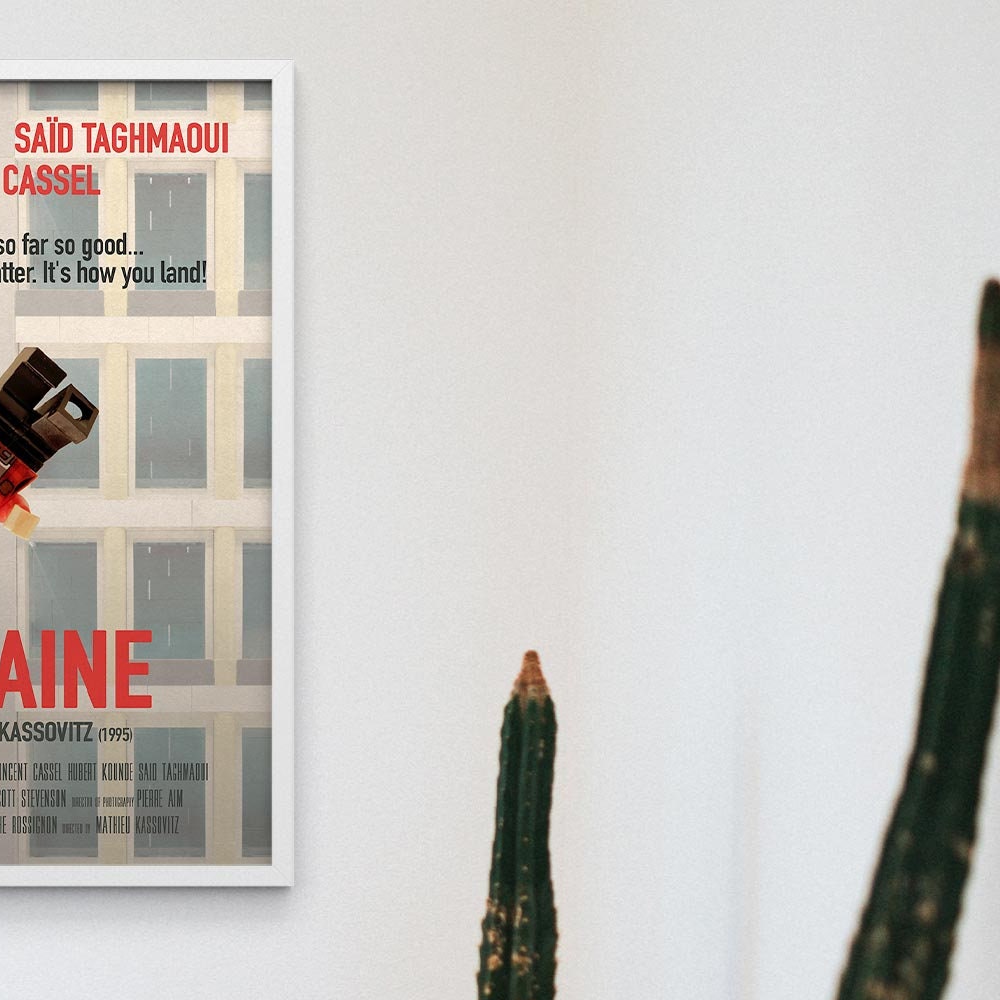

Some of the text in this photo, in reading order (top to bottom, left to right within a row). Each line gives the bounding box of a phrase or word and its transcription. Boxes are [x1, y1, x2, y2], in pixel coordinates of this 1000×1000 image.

[14, 116, 229, 154] SAÏD TAGHMAOUI
[2, 164, 101, 196] CASSEL
[21, 232, 49, 256] far
[54, 238, 76, 256] so
[81, 232, 144, 260] good...
[42, 260, 72, 284] It's
[76, 260, 116, 284] how
[121, 267, 155, 289] you
[159, 260, 208, 284] land!
[97, 727, 134, 744] (1995)
[32, 762, 63, 781] CASSEL
[68, 762, 97, 781] HUBERT
[102, 762, 134, 781] KOUNDE
[138, 762, 157, 781] SAID
[162, 762, 209, 781] TAGHMAOUI
[21, 789, 67, 808] STEVENSON
[137, 789, 163, 808] PIERRE
[168, 789, 184, 808] AIM
[12, 815, 58, 834] ROSSIGNON
[96, 815, 131, 834] MATHIEU
[135, 815, 180, 834] KASSOVITZ
